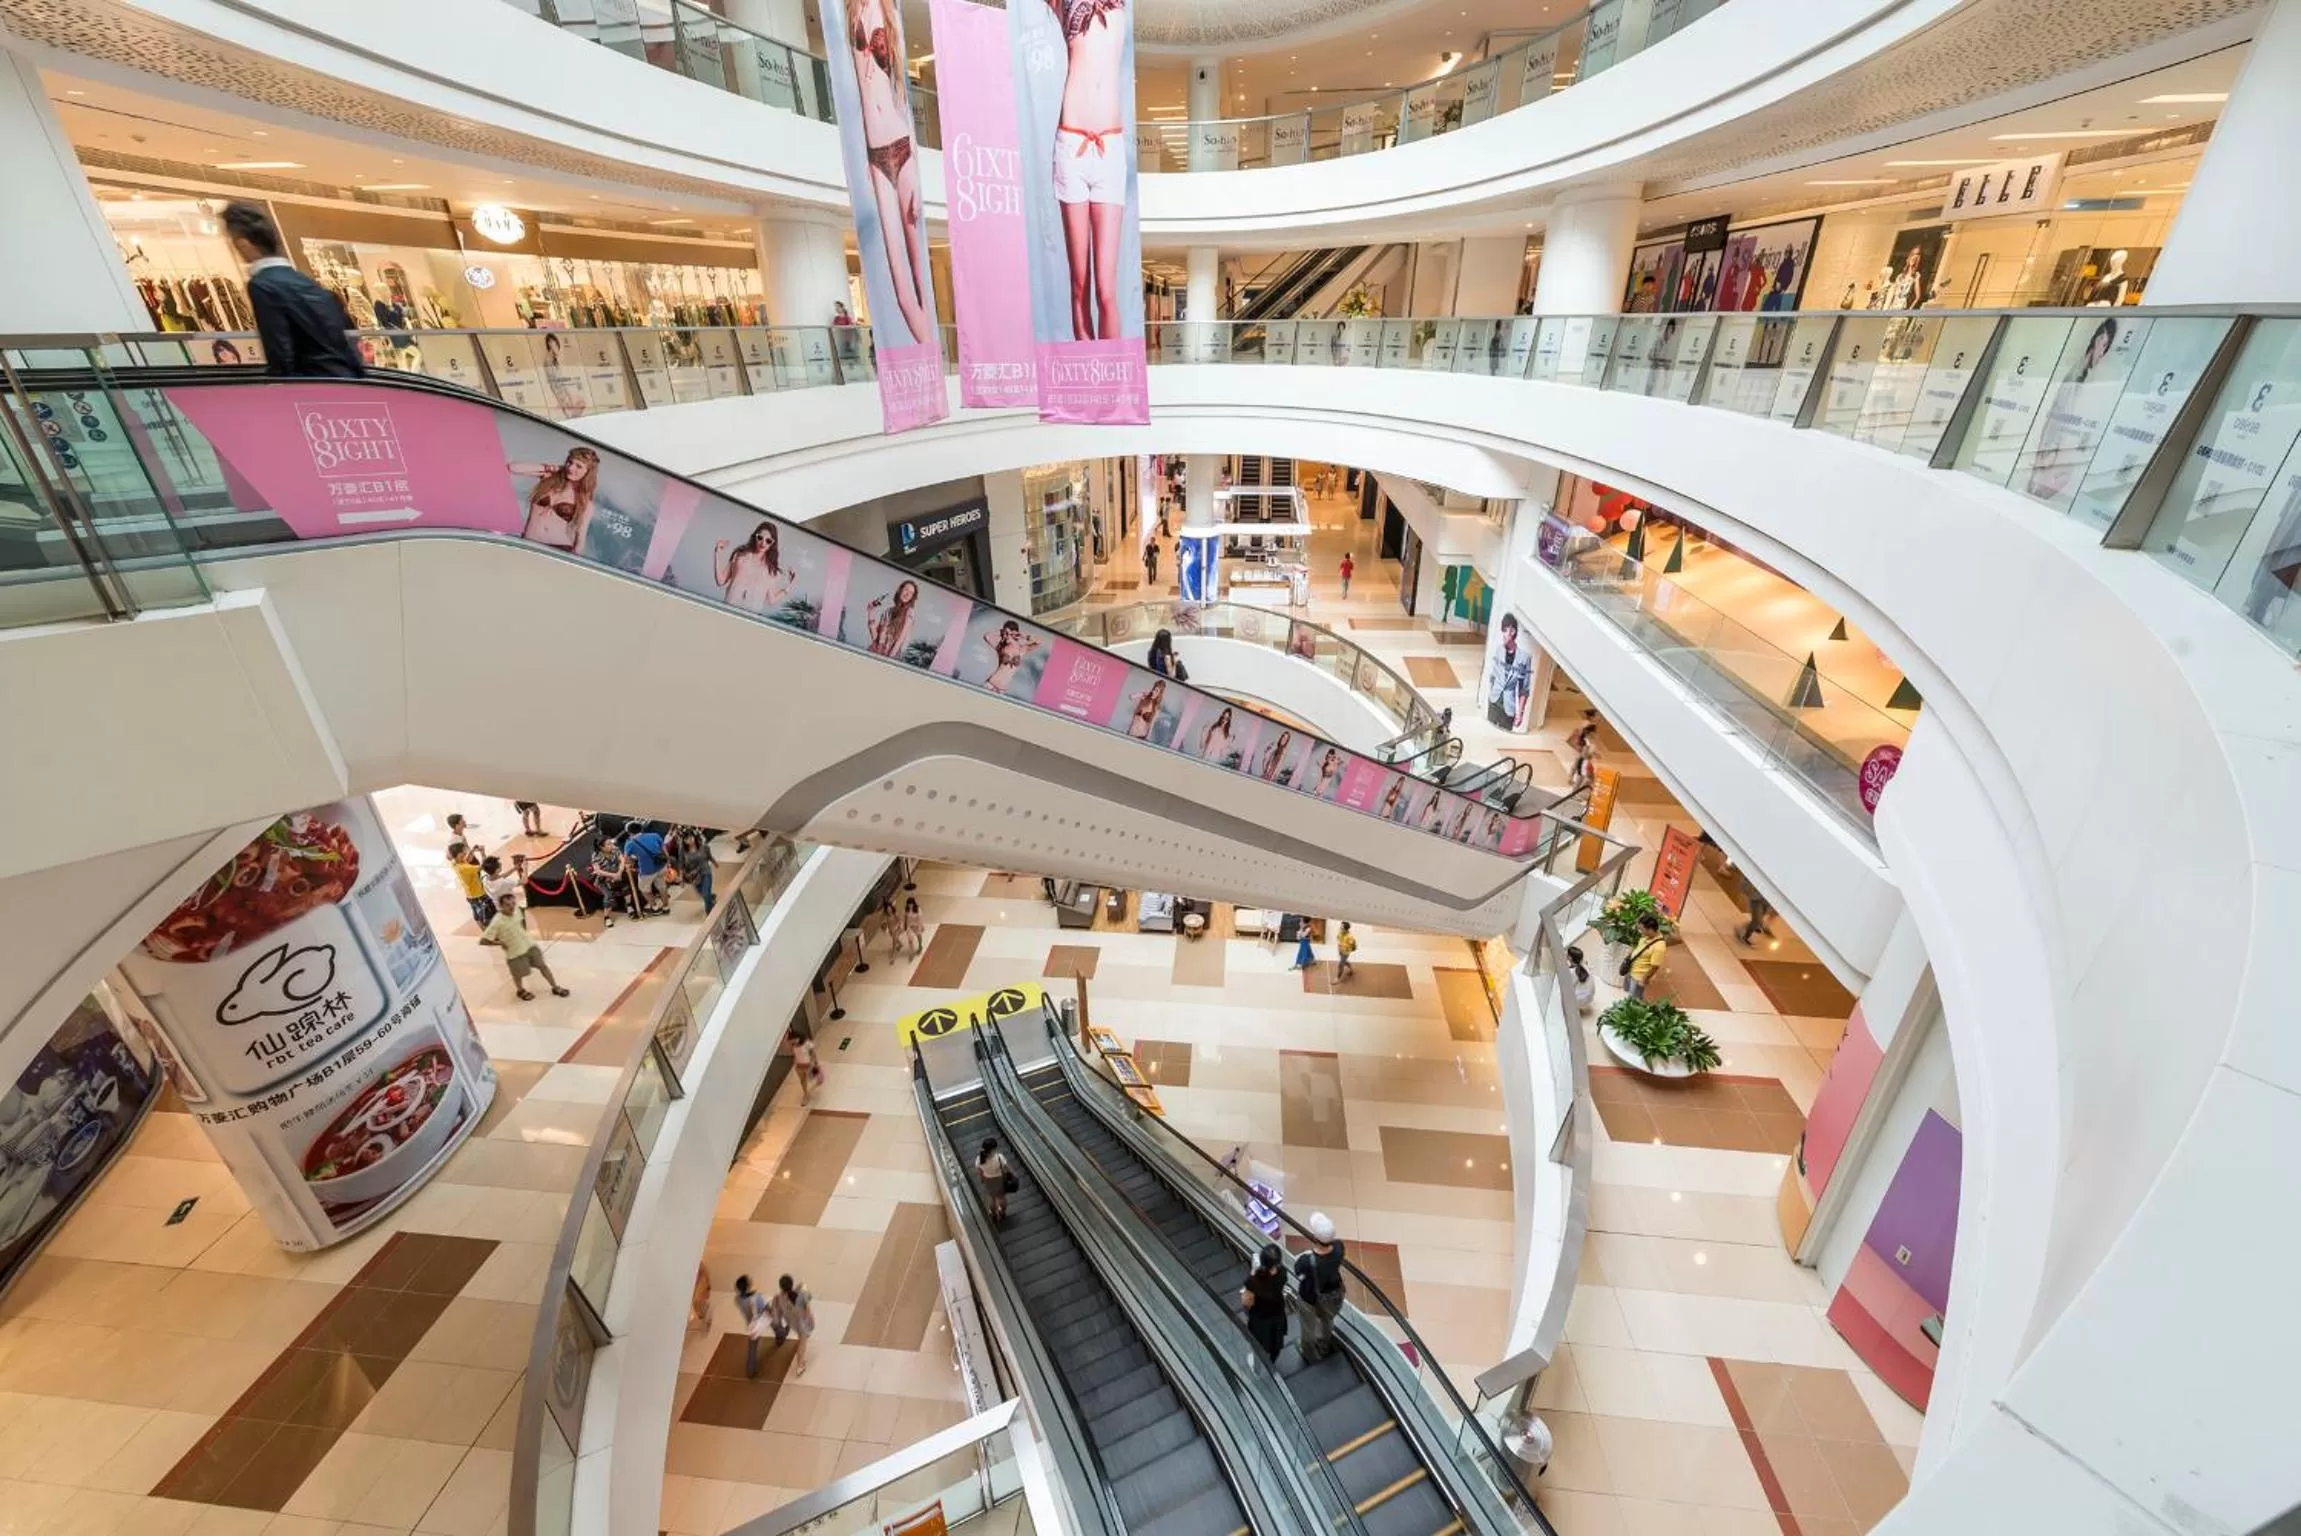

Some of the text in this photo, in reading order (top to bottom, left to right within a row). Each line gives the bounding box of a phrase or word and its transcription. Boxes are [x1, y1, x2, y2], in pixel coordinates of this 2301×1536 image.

[952, 132, 1021, 180] 6IXT
[956, 177, 1022, 222] 8IGH
[1952, 165, 2043, 209] ELLE
[305, 412, 391, 442] 6IXTY
[314, 439, 395, 468] 8IGHT
[920, 508, 981, 538] SUPER HEROES
[245, 990, 352, 1061] 仙踪林
[265, 1012, 355, 1069] rbt tea cafe
